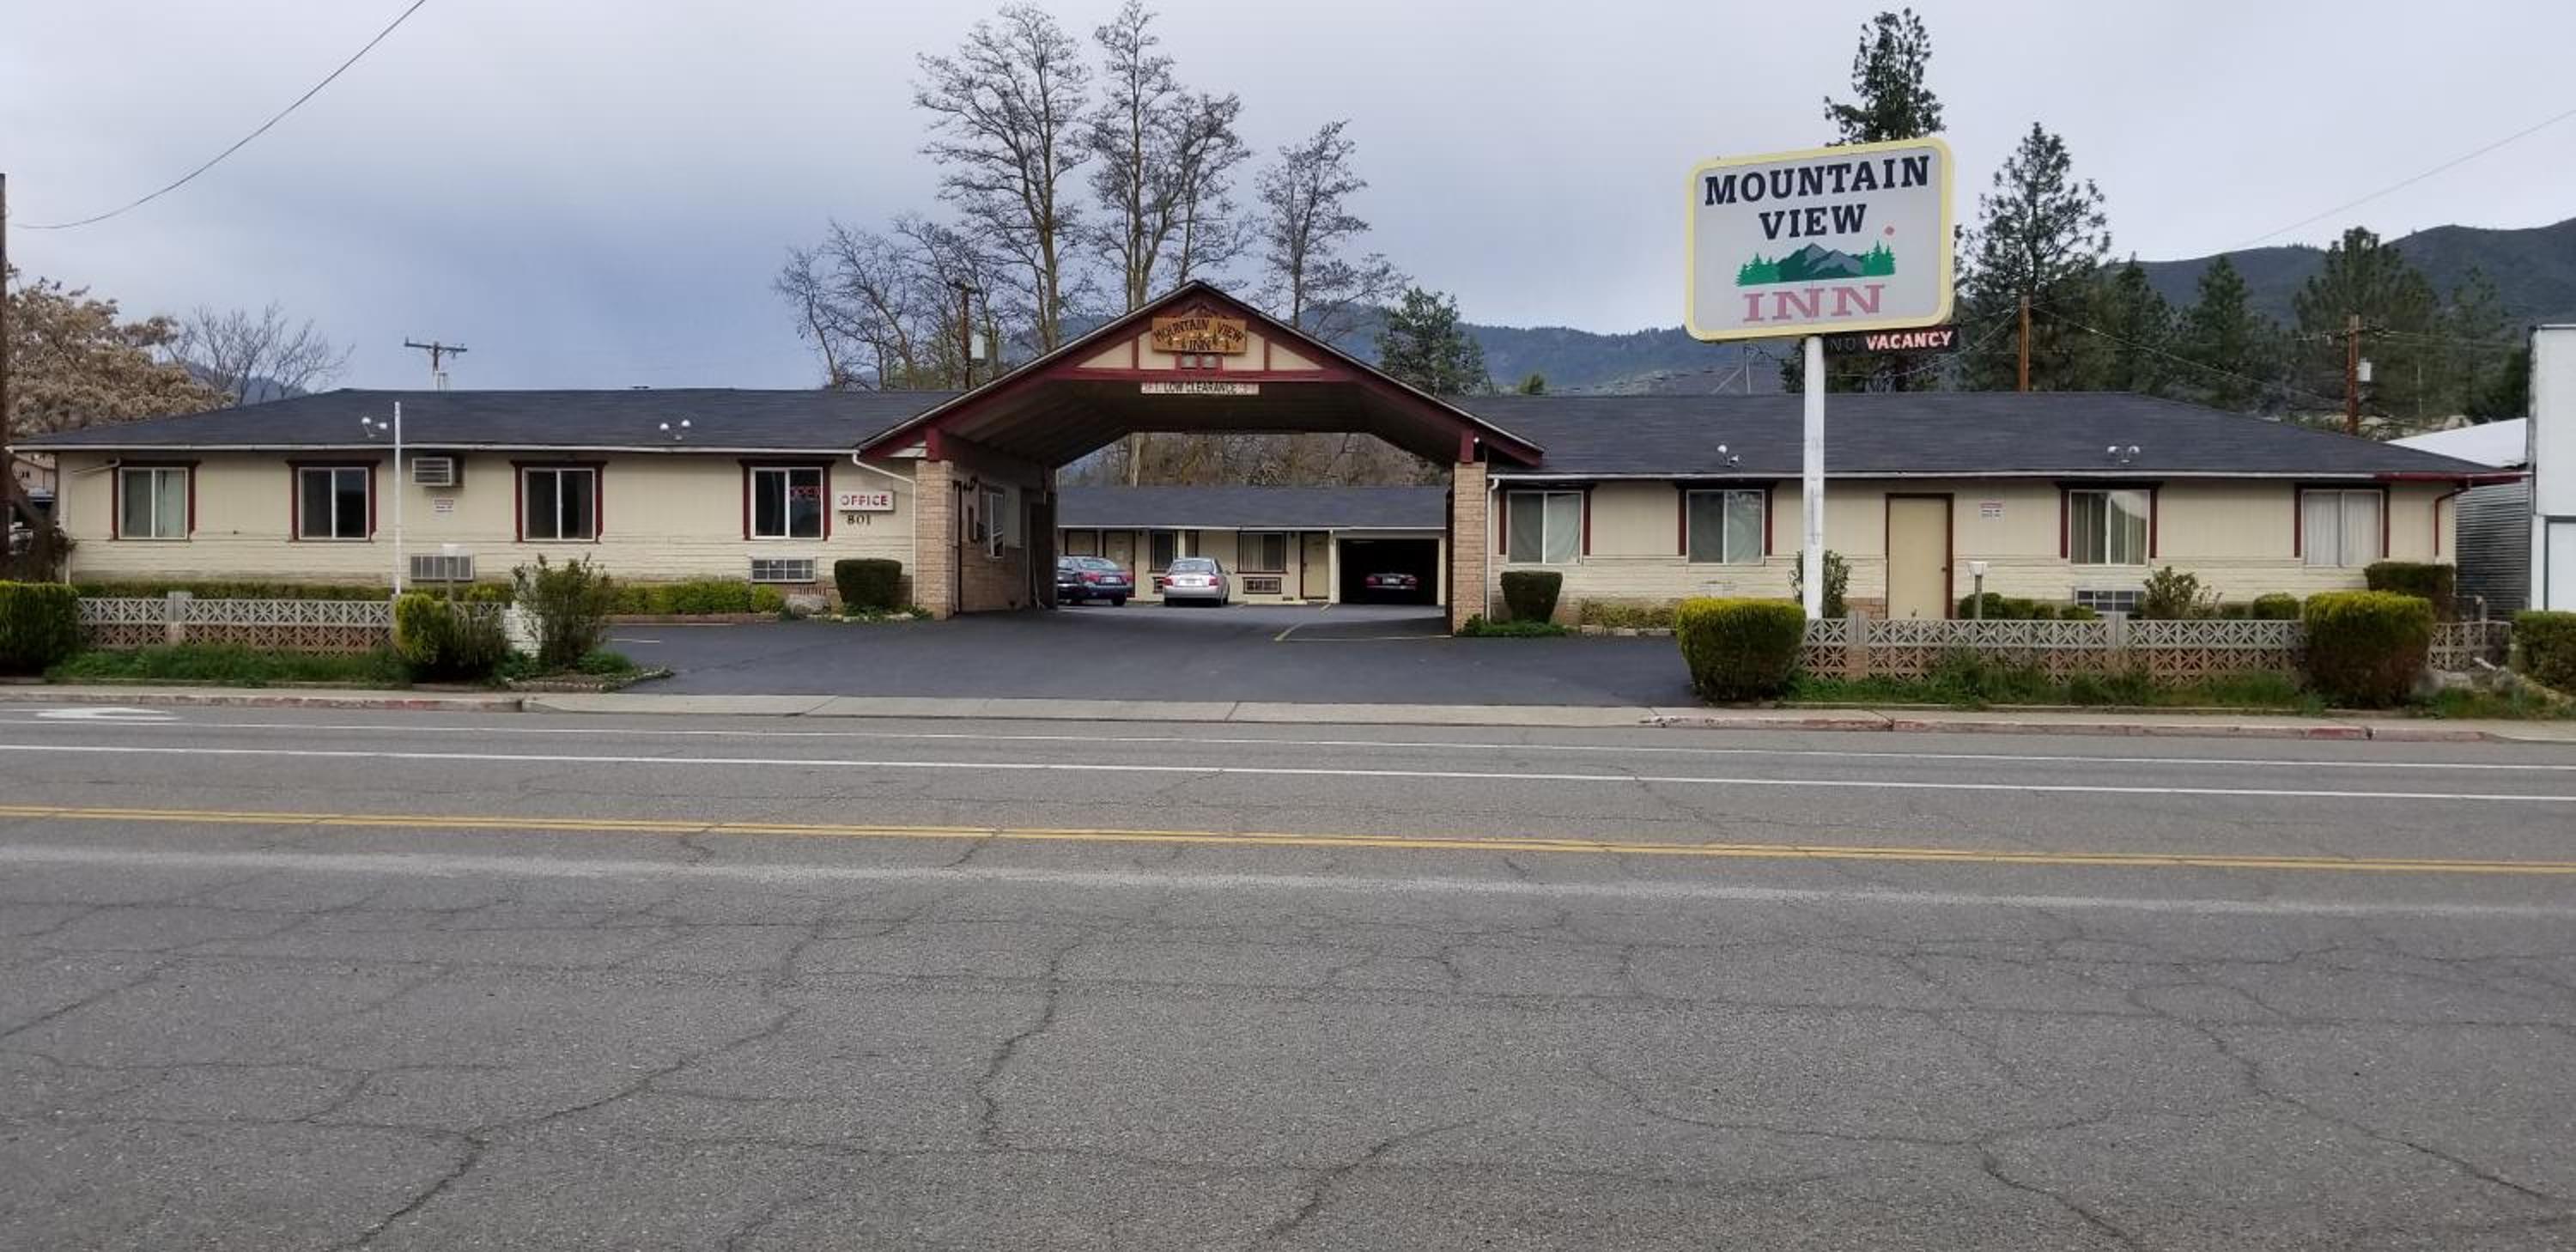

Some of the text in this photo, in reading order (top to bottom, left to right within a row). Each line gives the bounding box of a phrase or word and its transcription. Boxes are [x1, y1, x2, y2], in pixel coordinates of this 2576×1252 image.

[1704, 155, 1929, 206] MOUNTAIN
[1759, 204, 1867, 240] VIEW
[1743, 284, 1886, 322] INN
[1154, 319, 1245, 343] MOUNTAIN VIEW
[1830, 331, 1953, 352] NO VACANCY
[1188, 340, 1211, 351] INN
[1164, 383, 1183, 392] LOW
[839, 495, 888, 506] OFFICE
[847, 514, 871, 525] 801
